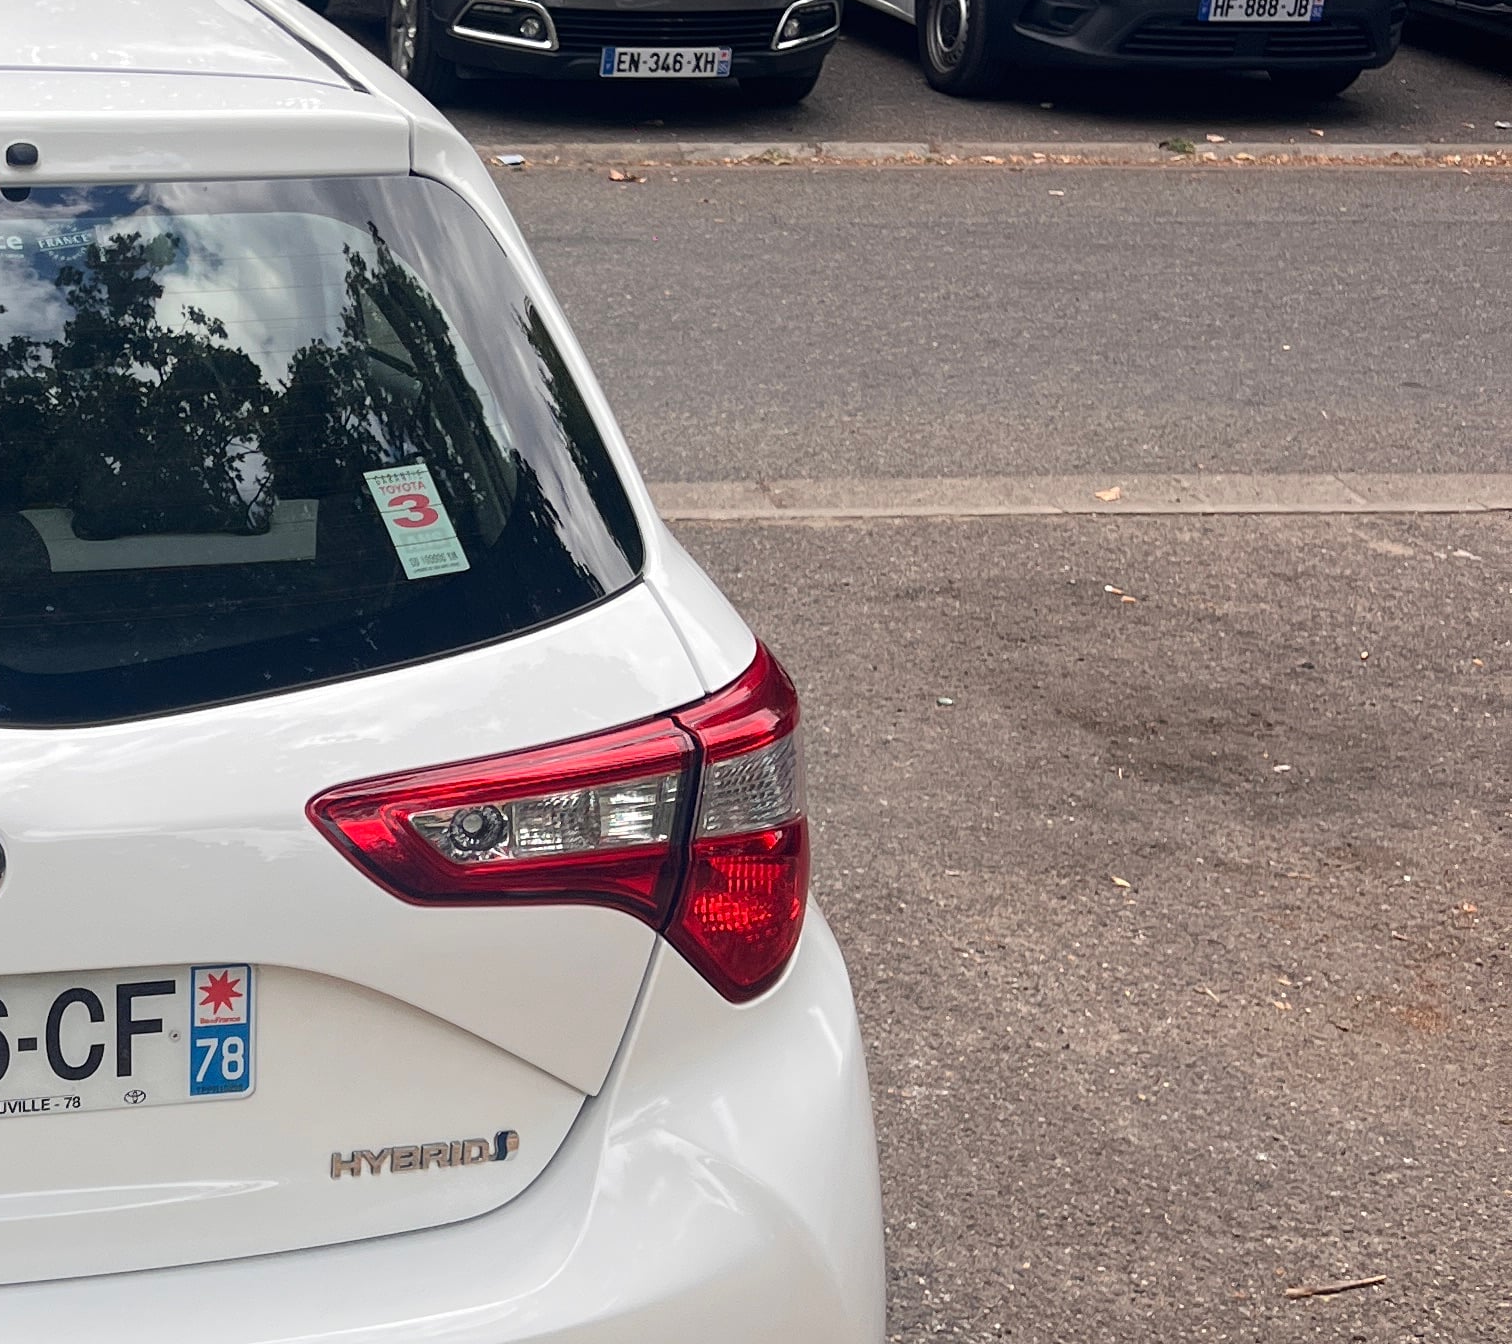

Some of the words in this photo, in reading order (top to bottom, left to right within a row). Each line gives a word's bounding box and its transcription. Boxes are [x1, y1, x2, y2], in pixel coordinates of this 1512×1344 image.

[616, 52, 716, 73] EN-346-XH
[378, 480, 426, 495] TOYOTA
[388, 493, 439, 528] 3
[195, 1036, 245, 1083] 78
[64, 1096, 81, 1109] 78
[330, 1138, 490, 1179] HYBRID
